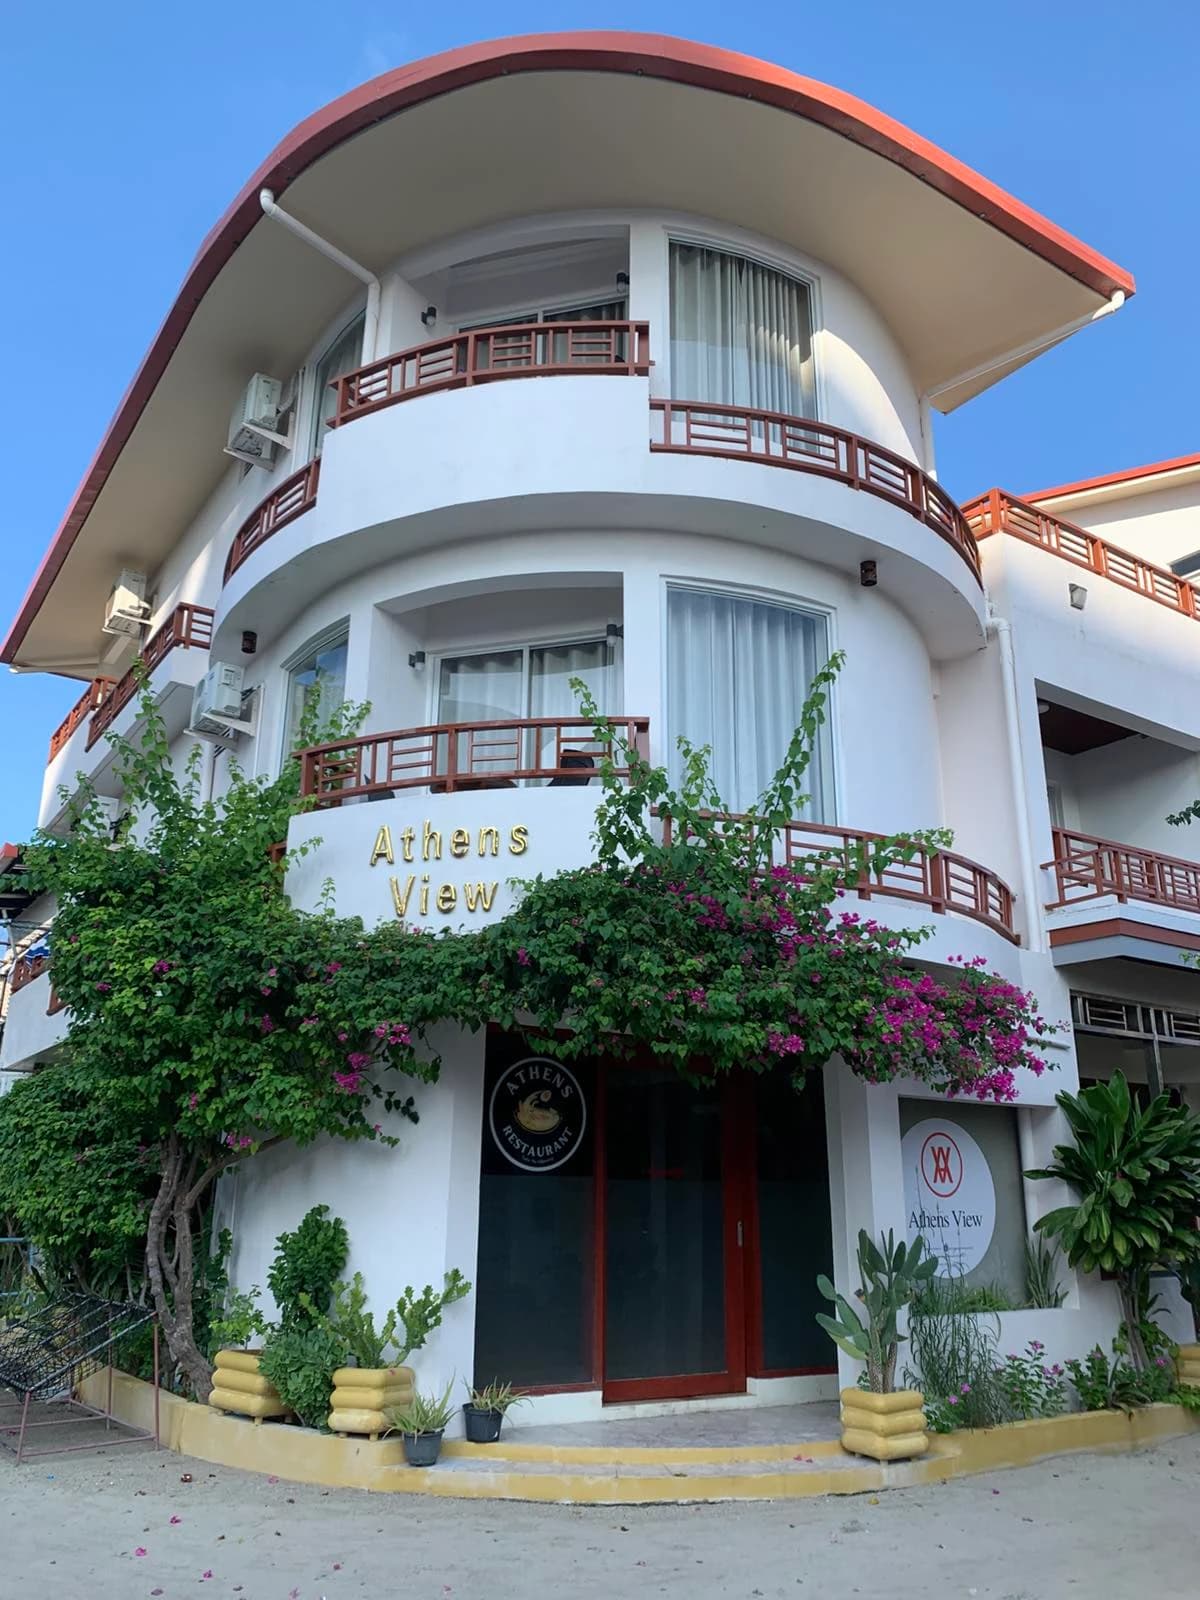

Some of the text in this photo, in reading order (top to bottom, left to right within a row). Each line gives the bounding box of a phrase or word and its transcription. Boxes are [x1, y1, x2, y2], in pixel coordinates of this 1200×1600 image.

[370, 818, 529, 866] Athens
[389, 873, 499, 917] View
[506, 1065, 573, 1098] ATHENS
[503, 1125, 572, 1158] RESTAURANT
[909, 1210, 983, 1229] Athens View
